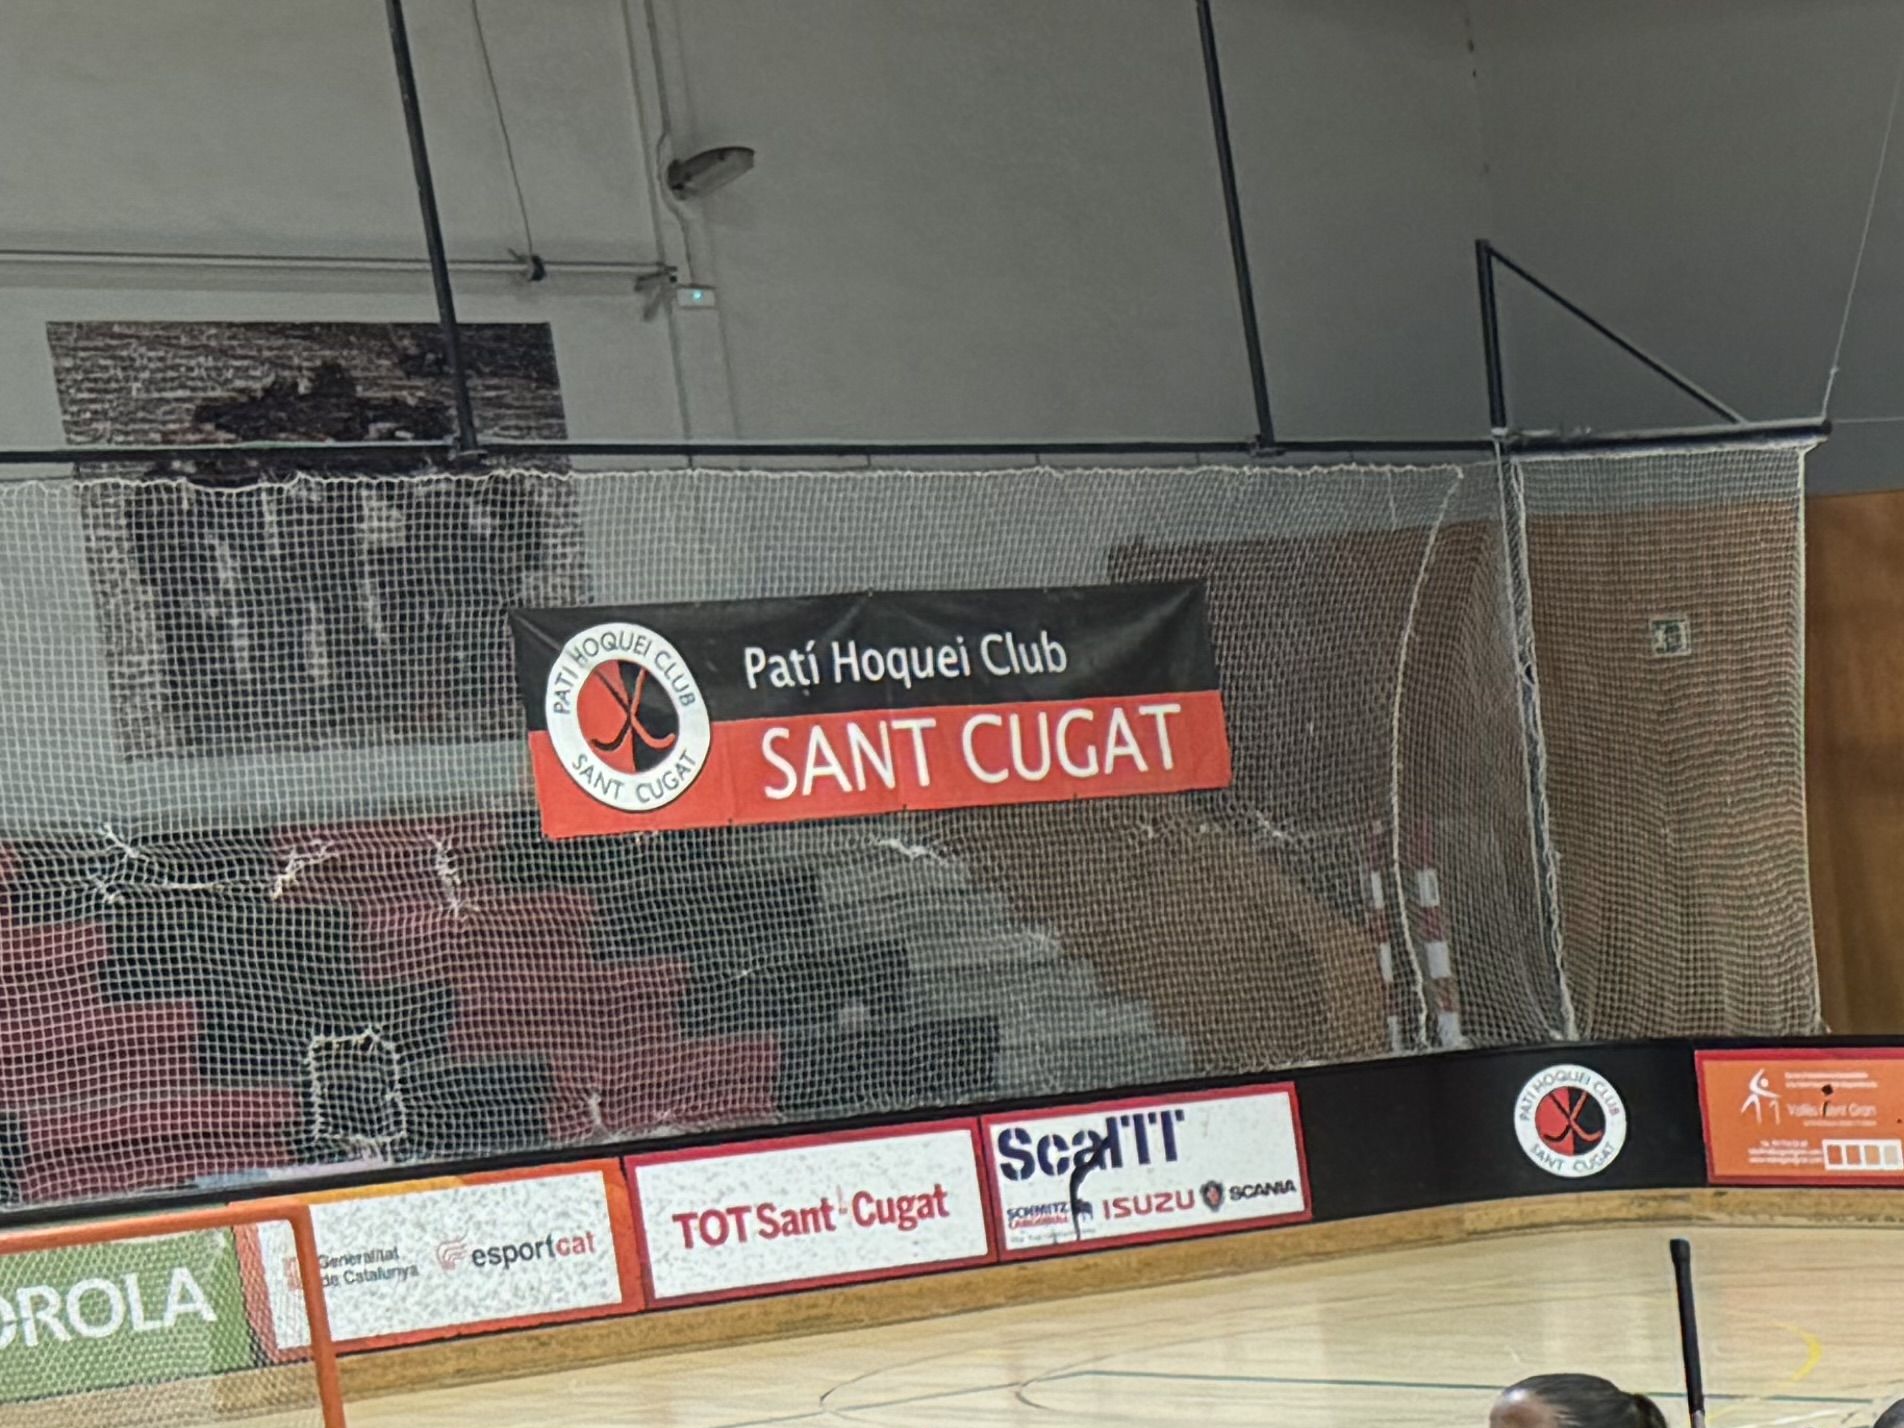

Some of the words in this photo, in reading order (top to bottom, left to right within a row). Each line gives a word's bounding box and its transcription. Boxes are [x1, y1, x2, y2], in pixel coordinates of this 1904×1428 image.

[553, 665, 579, 715] PATI
[569, 630, 653, 669] HOQUEI
[654, 650, 696, 707] CLUB
[744, 640, 820, 689] Patí
[831, 636, 970, 689] Hoquei
[980, 630, 1068, 676] Club
[572, 753, 625, 800] SANT
[635, 749, 696, 804] CUGAT
[761, 717, 937, 799] SANT
[962, 703, 1181, 784] CUGAT
[673, 1206, 752, 1250] TOT
[759, 1189, 838, 1241] Sant
[851, 1184, 951, 1231] Cugat
[1102, 1189, 1196, 1221] ISUZU
[1228, 1179, 1297, 1201] SCANIA
[471, 1231, 597, 1270] esportcat
[0, 1265, 218, 1349] ROLA
